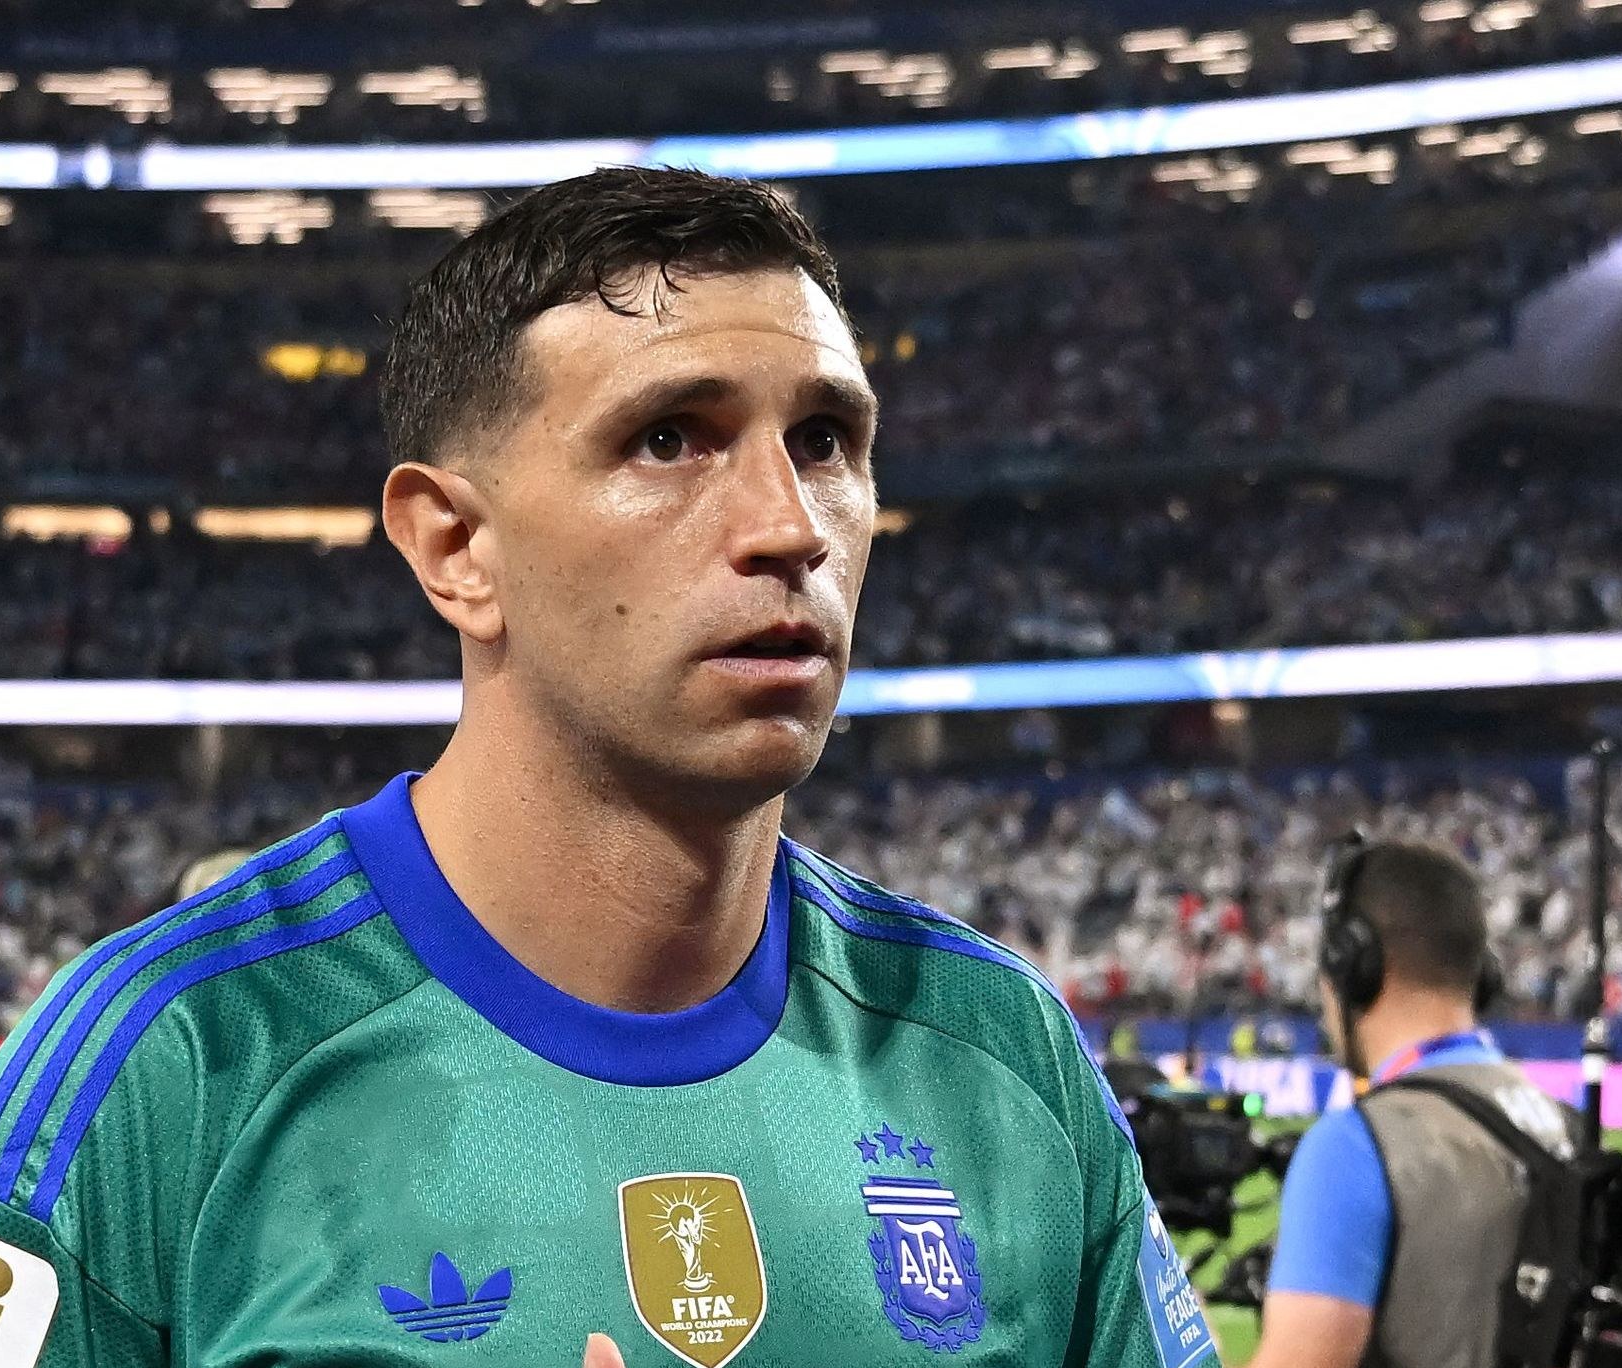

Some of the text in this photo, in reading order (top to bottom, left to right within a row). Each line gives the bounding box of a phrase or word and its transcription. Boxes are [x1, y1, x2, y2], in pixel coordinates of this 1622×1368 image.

[896, 1218, 963, 1300] AFA
[1164, 1282, 1200, 1335] PEACE
[660, 1317, 749, 1332] WORLD CHAMPIONS
[687, 1329, 724, 1345] 2022
[1179, 1323, 1202, 1348] FIFA
